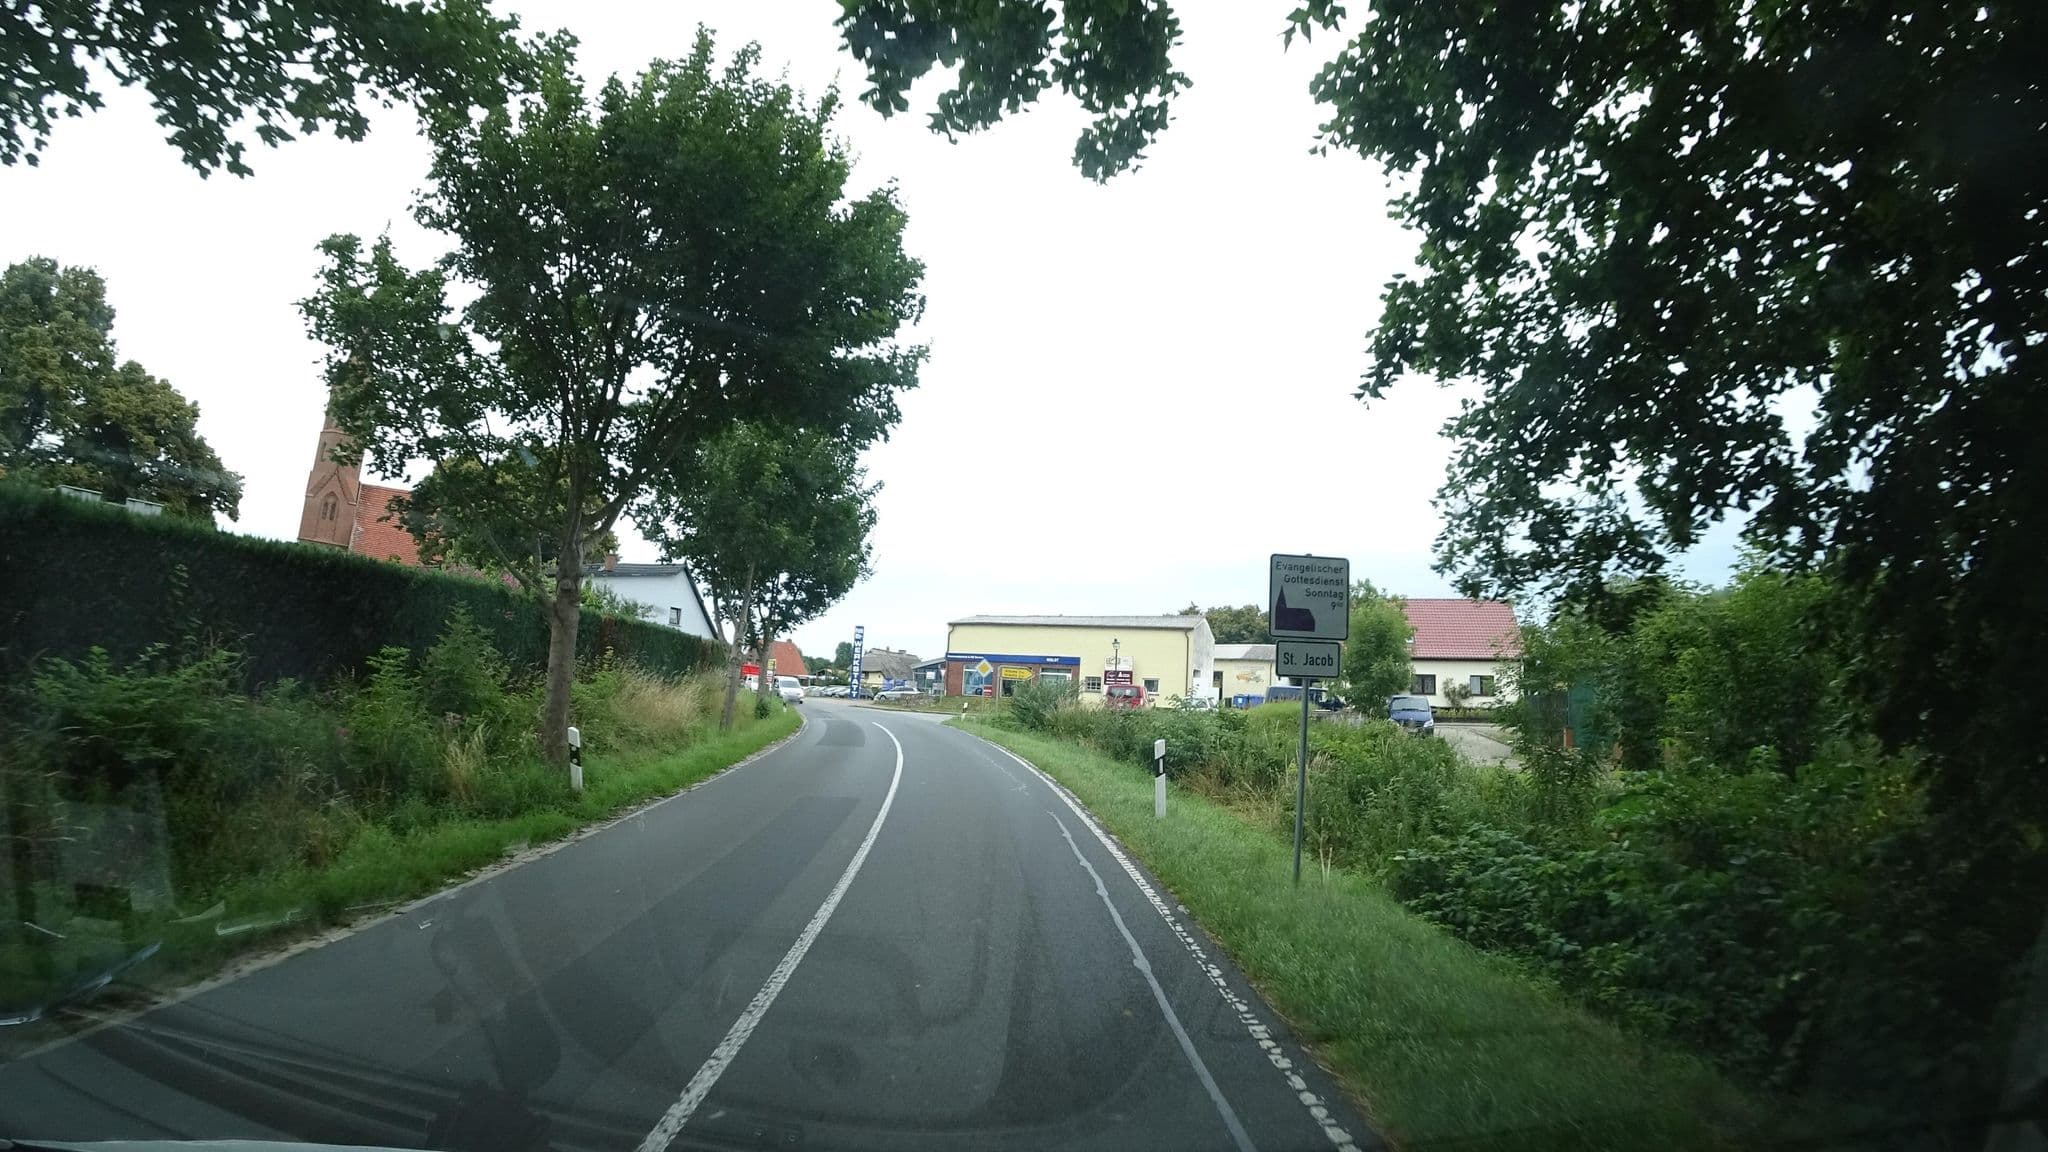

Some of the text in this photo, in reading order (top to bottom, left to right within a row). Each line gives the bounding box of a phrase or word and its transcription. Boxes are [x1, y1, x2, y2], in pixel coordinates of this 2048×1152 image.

[1276, 561, 1344, 574] Evangelischer
[1284, 574, 1344, 586] Gottesdienst
[1305, 587, 1344, 601] Sonntag
[1283, 652, 1334, 667] St. Jacob
[851, 640, 862, 698] WERKSTATT
